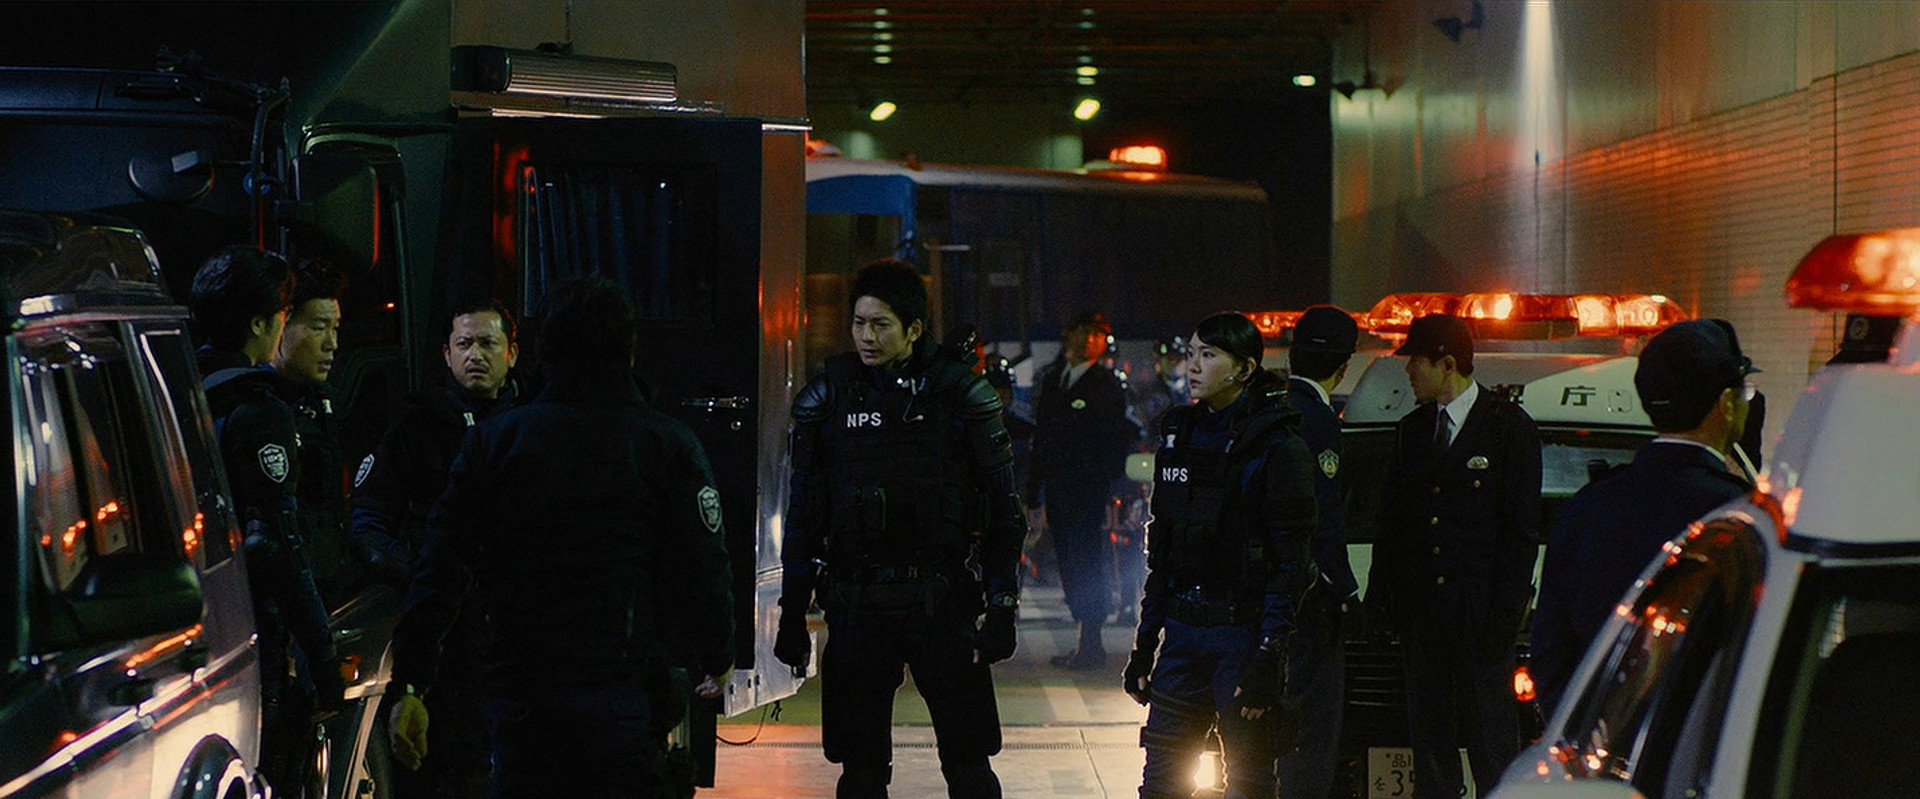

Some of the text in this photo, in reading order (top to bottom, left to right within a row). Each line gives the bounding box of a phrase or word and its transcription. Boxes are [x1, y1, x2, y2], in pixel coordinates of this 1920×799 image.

[847, 411, 882, 428] NPS
[1162, 467, 1189, 482] NPS
[1392, 754, 1412, 768] 品
